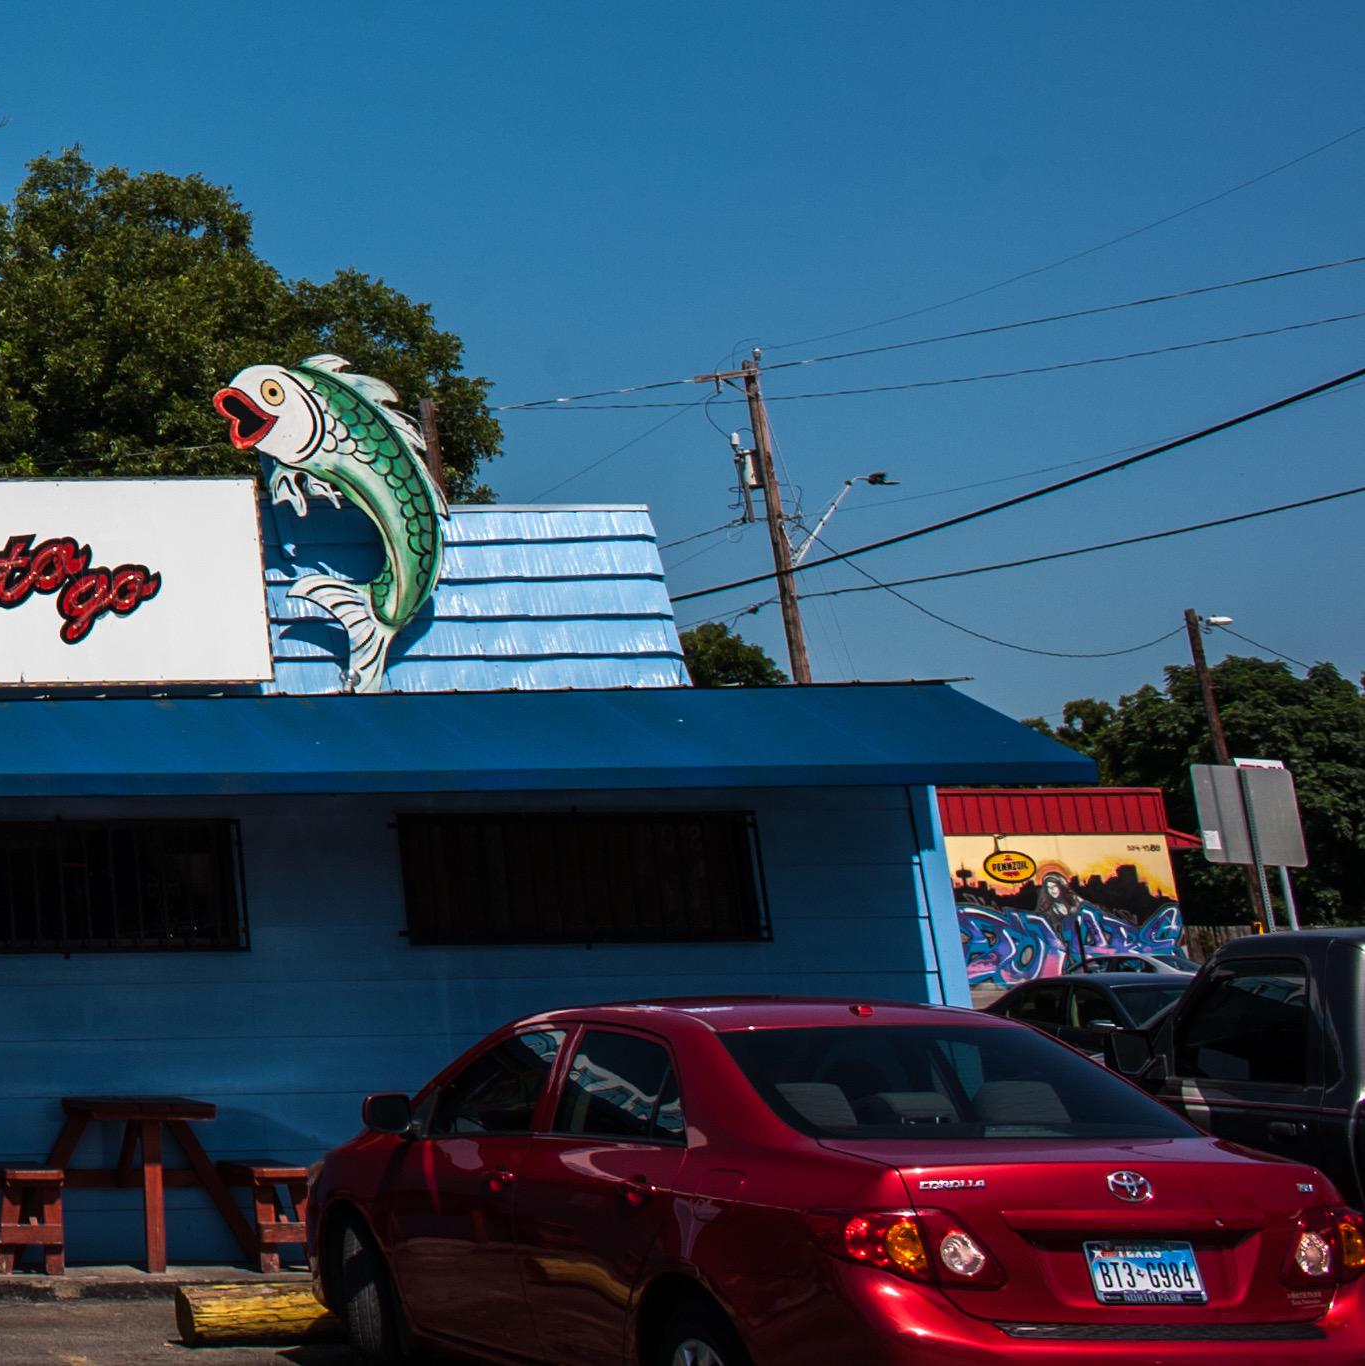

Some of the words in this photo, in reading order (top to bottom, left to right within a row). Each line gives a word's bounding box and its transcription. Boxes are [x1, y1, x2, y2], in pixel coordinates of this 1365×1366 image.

[60, 563, 162, 644] go
[992, 861, 1028, 872] PENNZOIL
[919, 1179, 985, 1190] COROLLA
[1114, 1244, 1162, 1258] TEXAS
[1099, 1262, 1136, 1288] BT3
[1146, 1262, 1195, 1288] G984
[1124, 1293, 1155, 1302] NORTH
[1157, 1293, 1184, 1302] PARK
